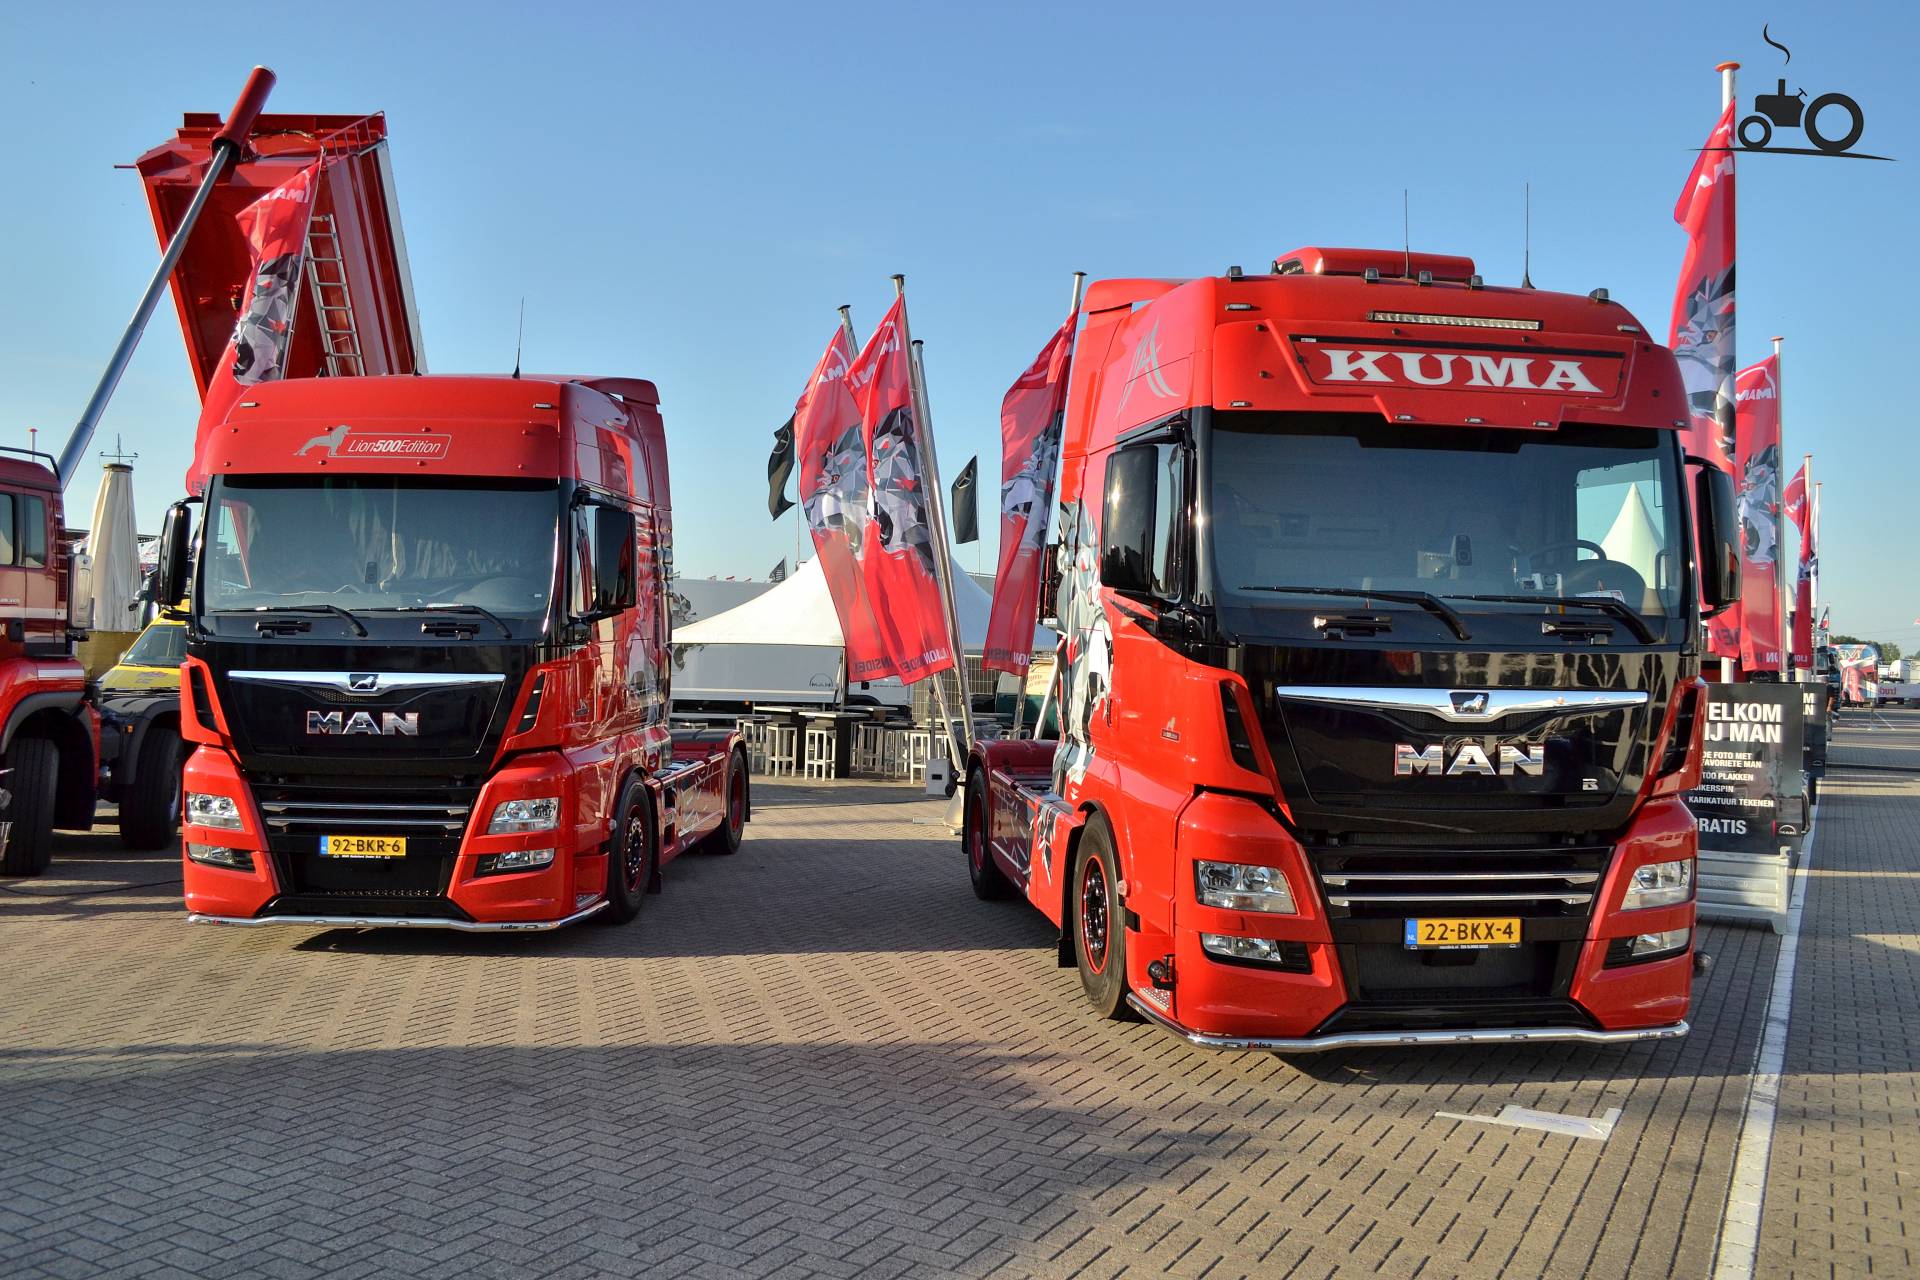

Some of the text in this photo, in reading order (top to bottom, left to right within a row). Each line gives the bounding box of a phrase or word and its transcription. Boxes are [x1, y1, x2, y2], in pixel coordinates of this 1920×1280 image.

[1320, 349, 1602, 392] KUMA
[1706, 702, 1782, 722] ELKOM
[307, 711, 418, 735] MAN
[1704, 722, 1781, 743] IJ MAN
[1395, 744, 1545, 775] MAN
[1713, 751, 1733, 759] FOTO
[1717, 773, 1754, 781] PLAKKEN
[1688, 796, 1774, 807] KARIKATUUR TEKENEN
[1699, 817, 1747, 835] RATIS
[333, 839, 400, 853] 92-BKR-6
[1425, 922, 1514, 941] 22-BKX-4
